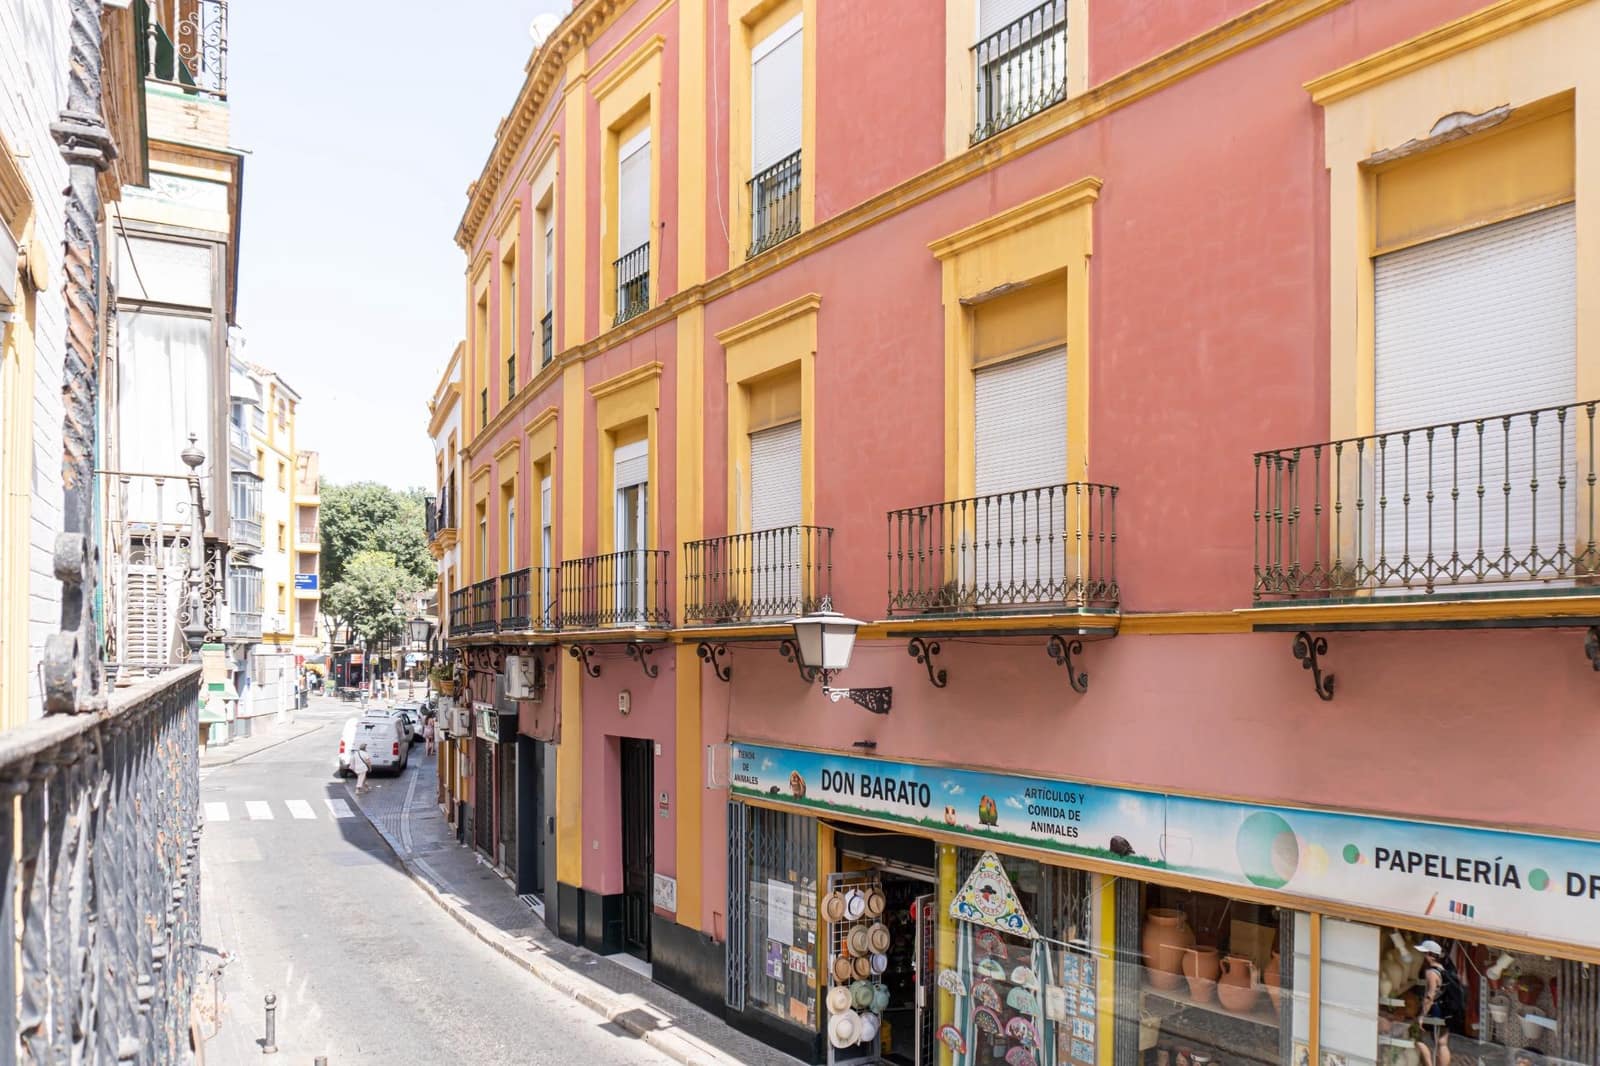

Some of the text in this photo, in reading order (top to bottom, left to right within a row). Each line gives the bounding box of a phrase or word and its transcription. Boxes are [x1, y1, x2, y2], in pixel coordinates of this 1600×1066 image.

[742, 762, 750, 772] DE
[734, 773, 759, 785] ANIMALES
[821, 768, 931, 808] DON BARATO
[1024, 787, 1085, 805] ARTÍCULOS Y
[1028, 804, 1081, 822] COMIDA DE
[1031, 821, 1079, 839] ANIMALES
[1374, 846, 1521, 890] PAPELERÍA
